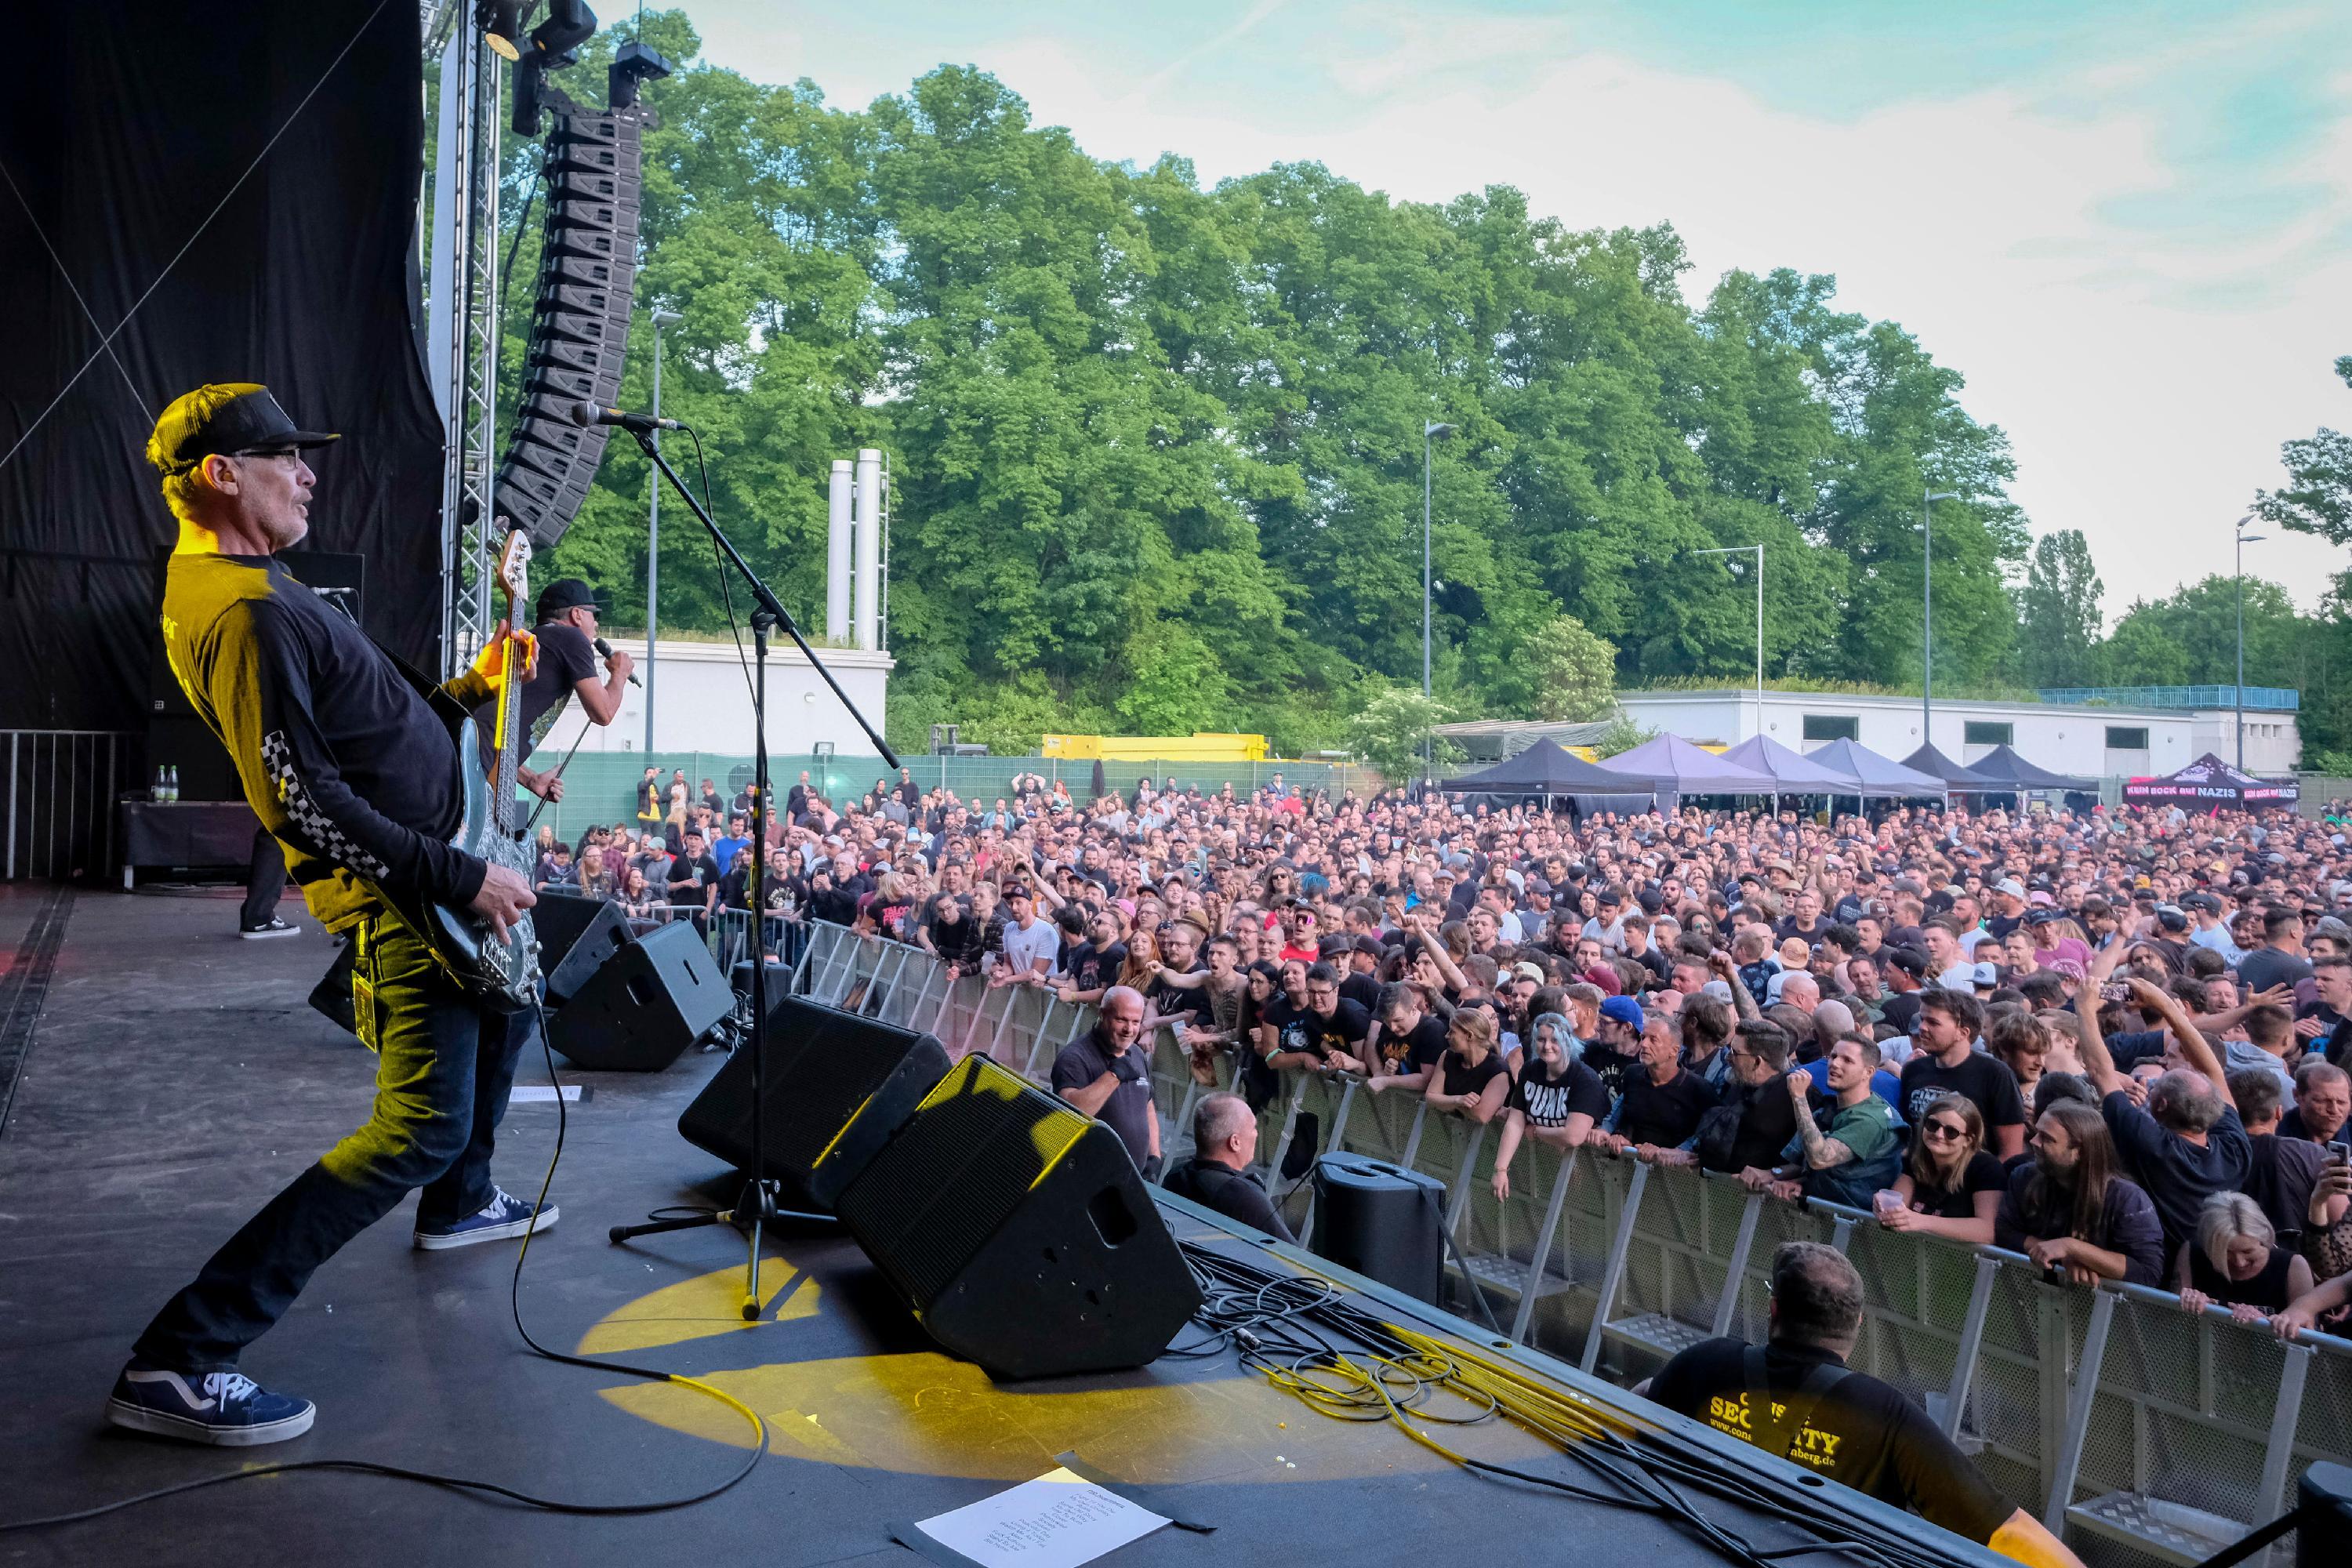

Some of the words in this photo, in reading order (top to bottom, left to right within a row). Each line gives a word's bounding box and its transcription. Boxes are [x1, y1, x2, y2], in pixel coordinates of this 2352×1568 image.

[2126, 786, 2149, 795] KEIN
[2151, 786, 2177, 795] BOCK
[2198, 786, 2237, 798] NAZIS
[2278, 789, 2297, 798] NAZIS
[1524, 1080, 1570, 1119] PUNK
